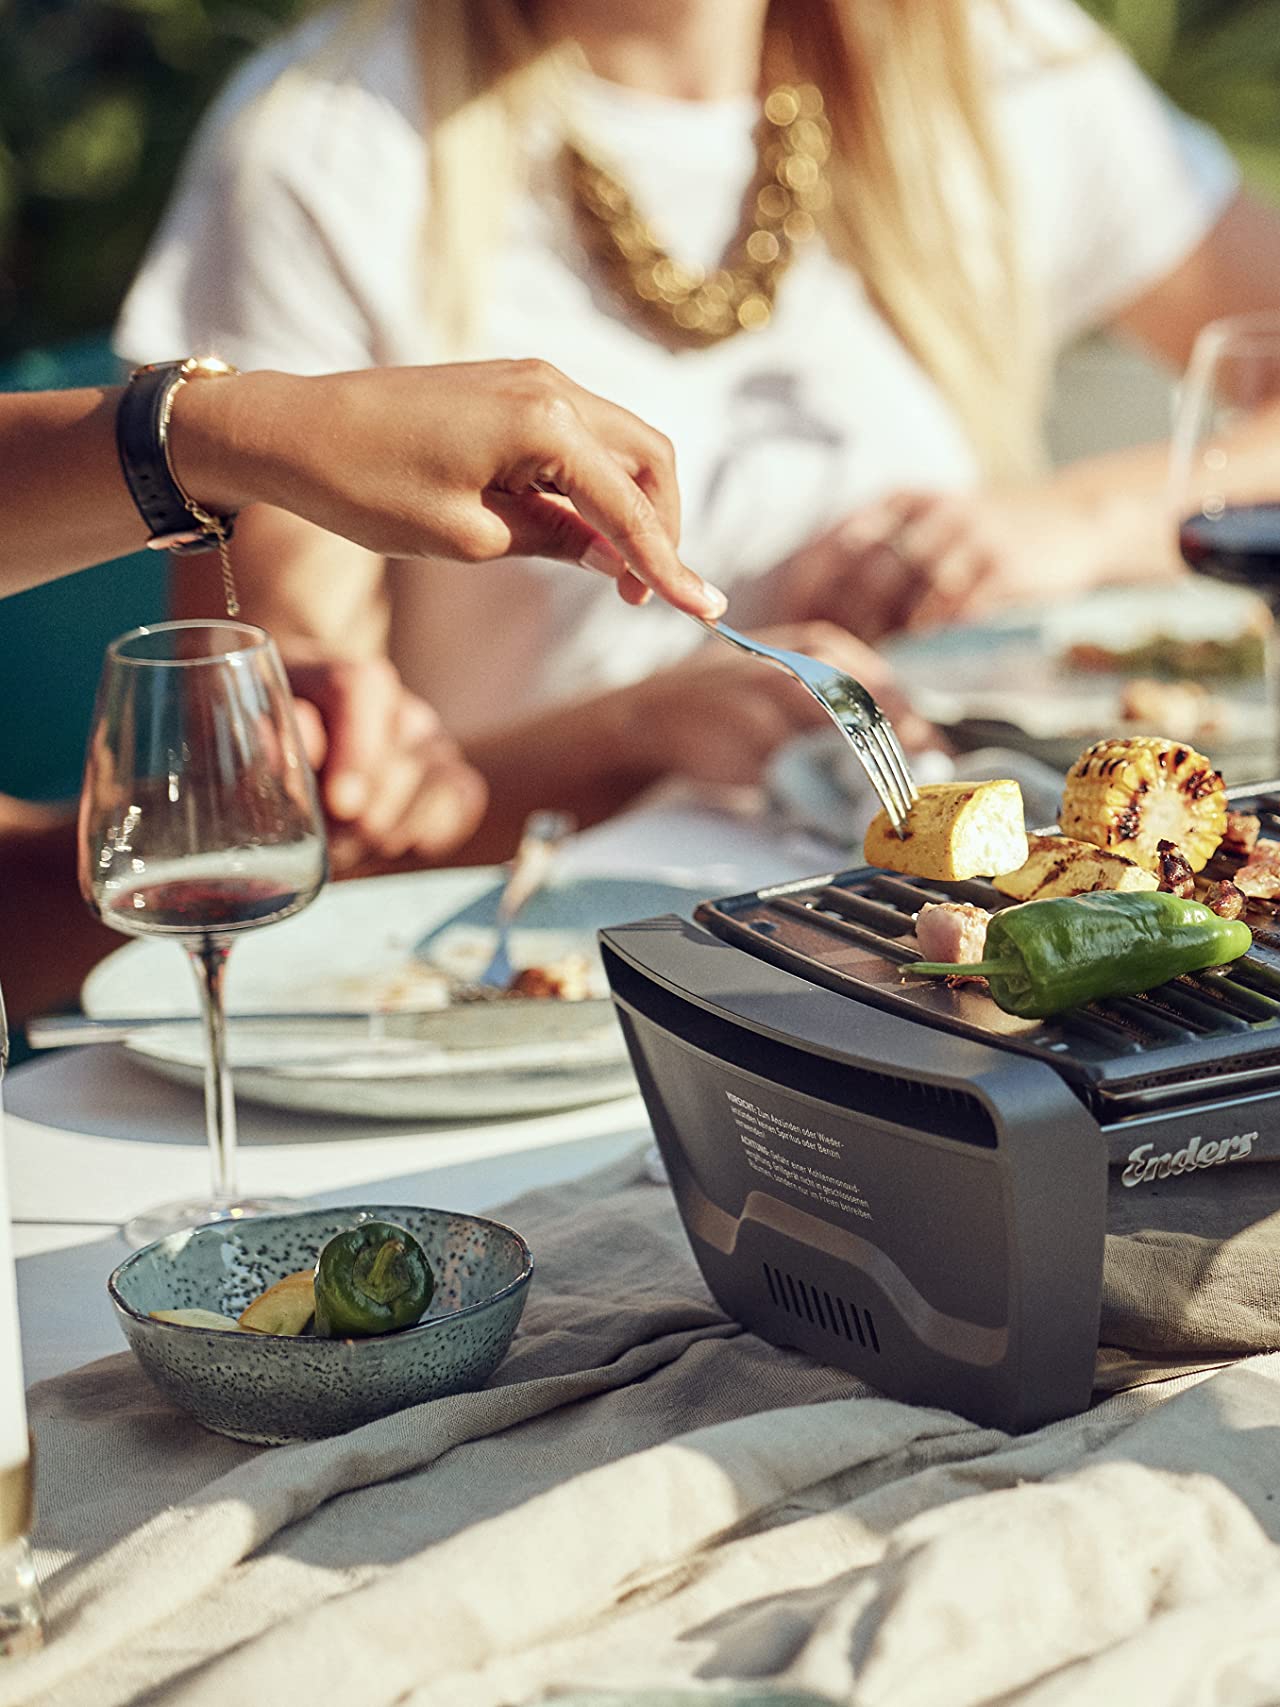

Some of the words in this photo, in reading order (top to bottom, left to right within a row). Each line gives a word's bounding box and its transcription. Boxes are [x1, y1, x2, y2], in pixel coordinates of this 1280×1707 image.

[801, 1127, 817, 1140] oder
[801, 1138, 817, 1151] oder
[1121, 1131, 1260, 1188] Enders
